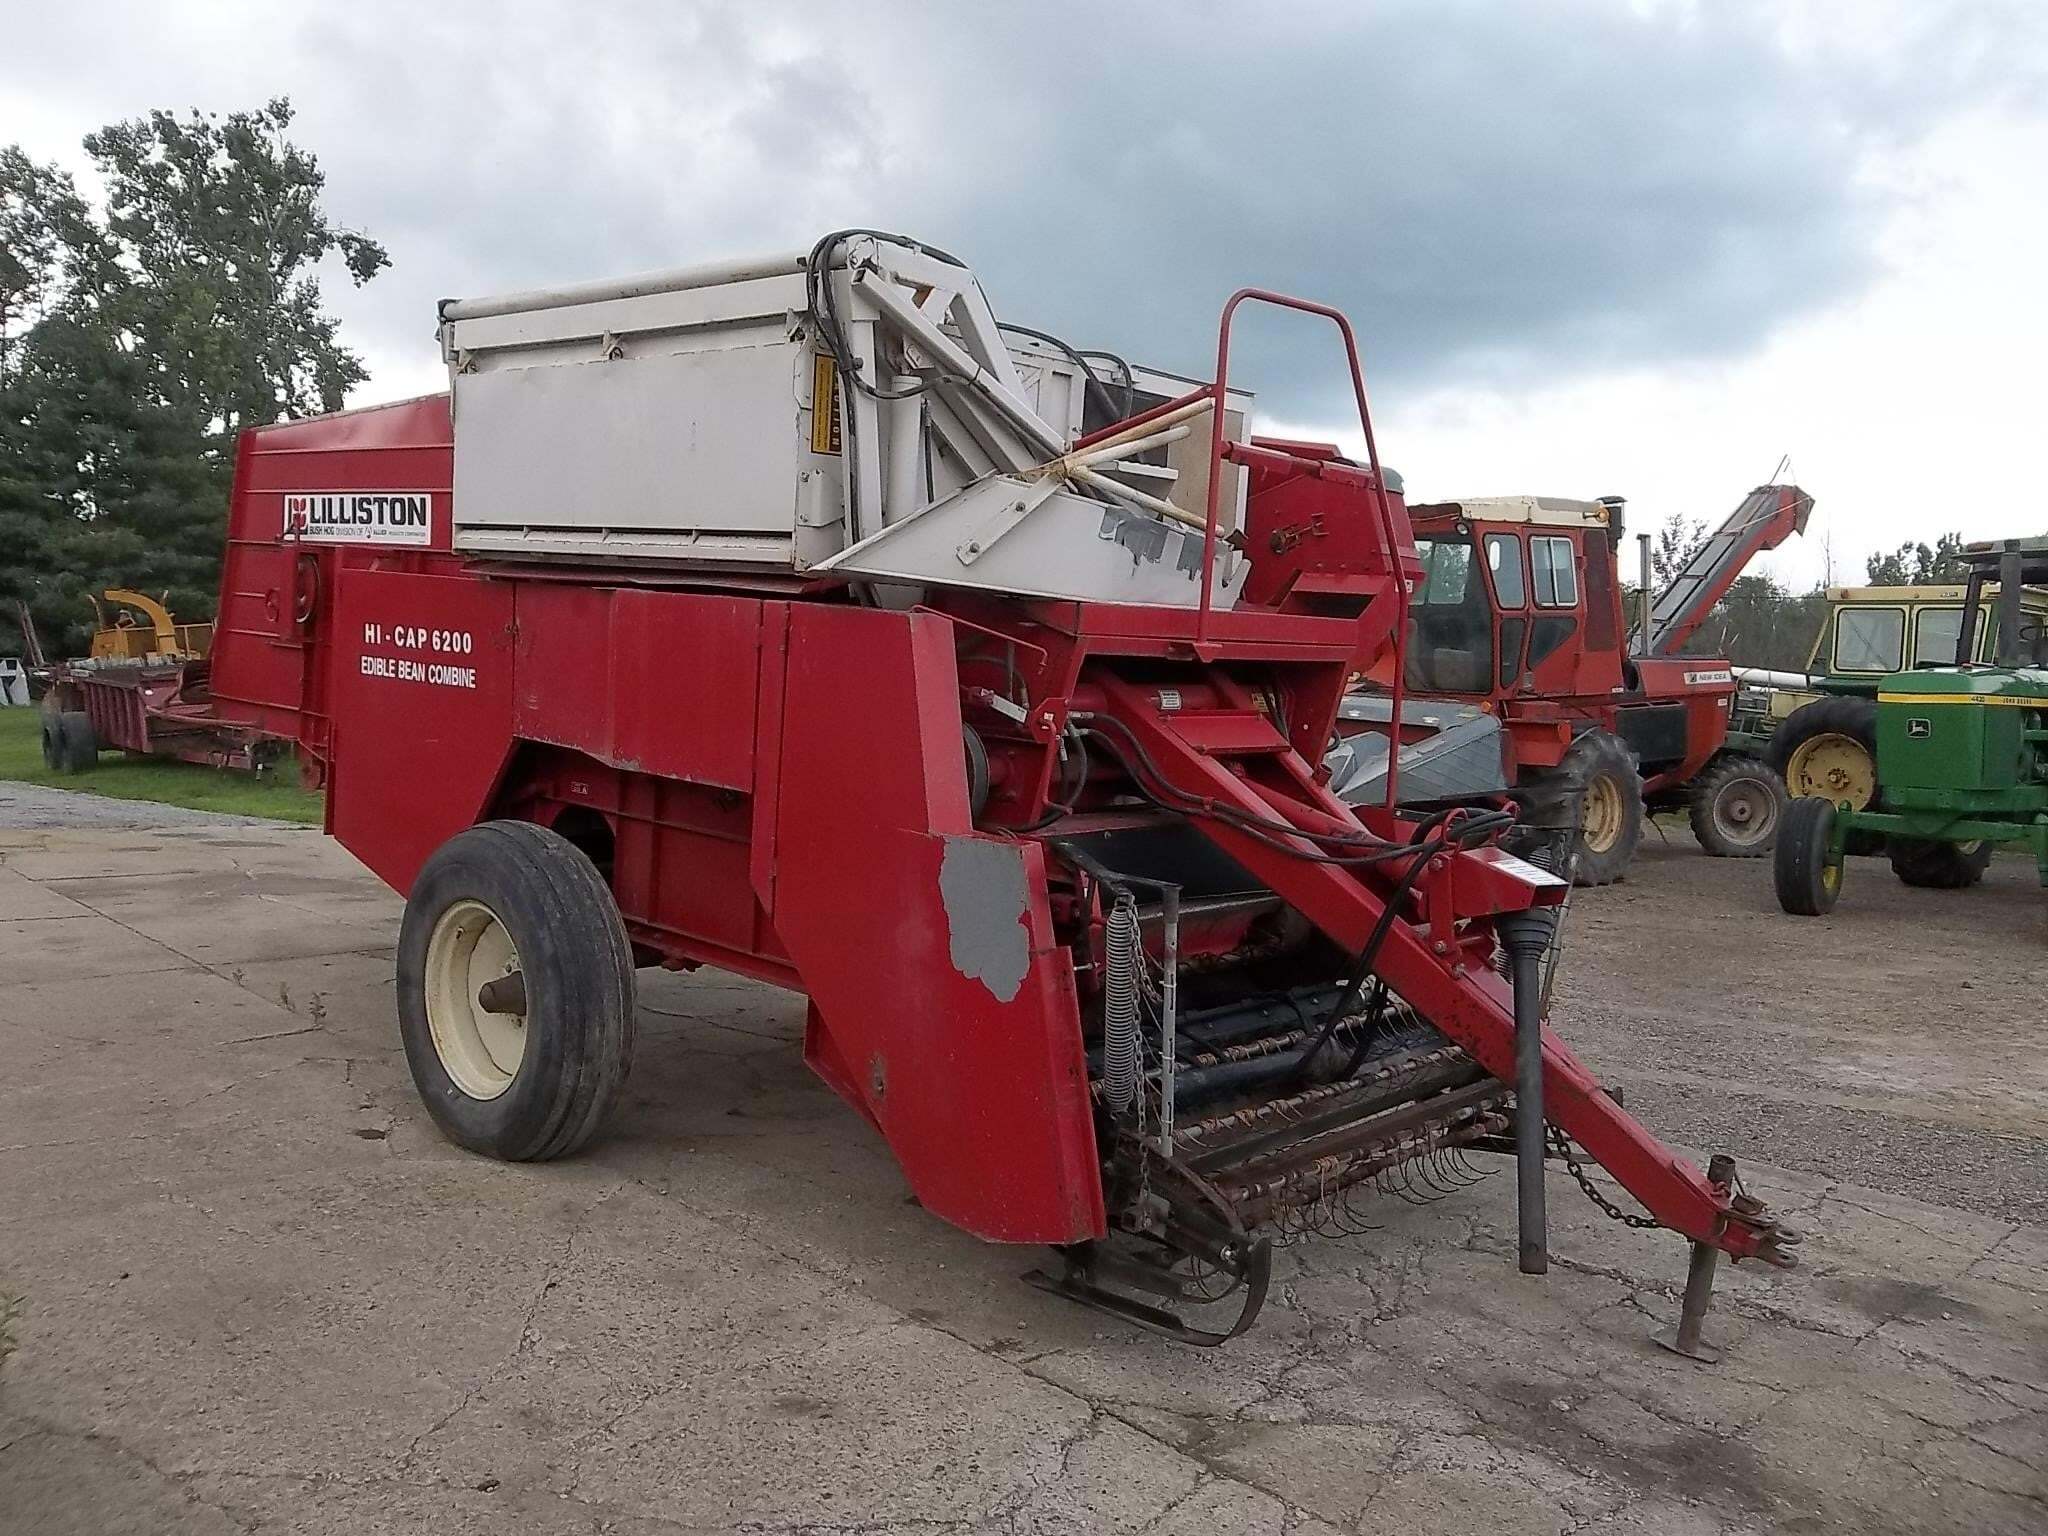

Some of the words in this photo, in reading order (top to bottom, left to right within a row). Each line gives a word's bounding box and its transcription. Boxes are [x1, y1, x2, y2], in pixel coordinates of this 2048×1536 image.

[310, 497, 427, 526] LILLISTON
[309, 526, 322, 535] BUSH
[324, 526, 335, 535] HOG
[432, 630, 472, 654] 6200
[361, 655, 396, 678] EDIBLE
[398, 660, 426, 682] BEAN
[428, 664, 476, 689] COMBINE
